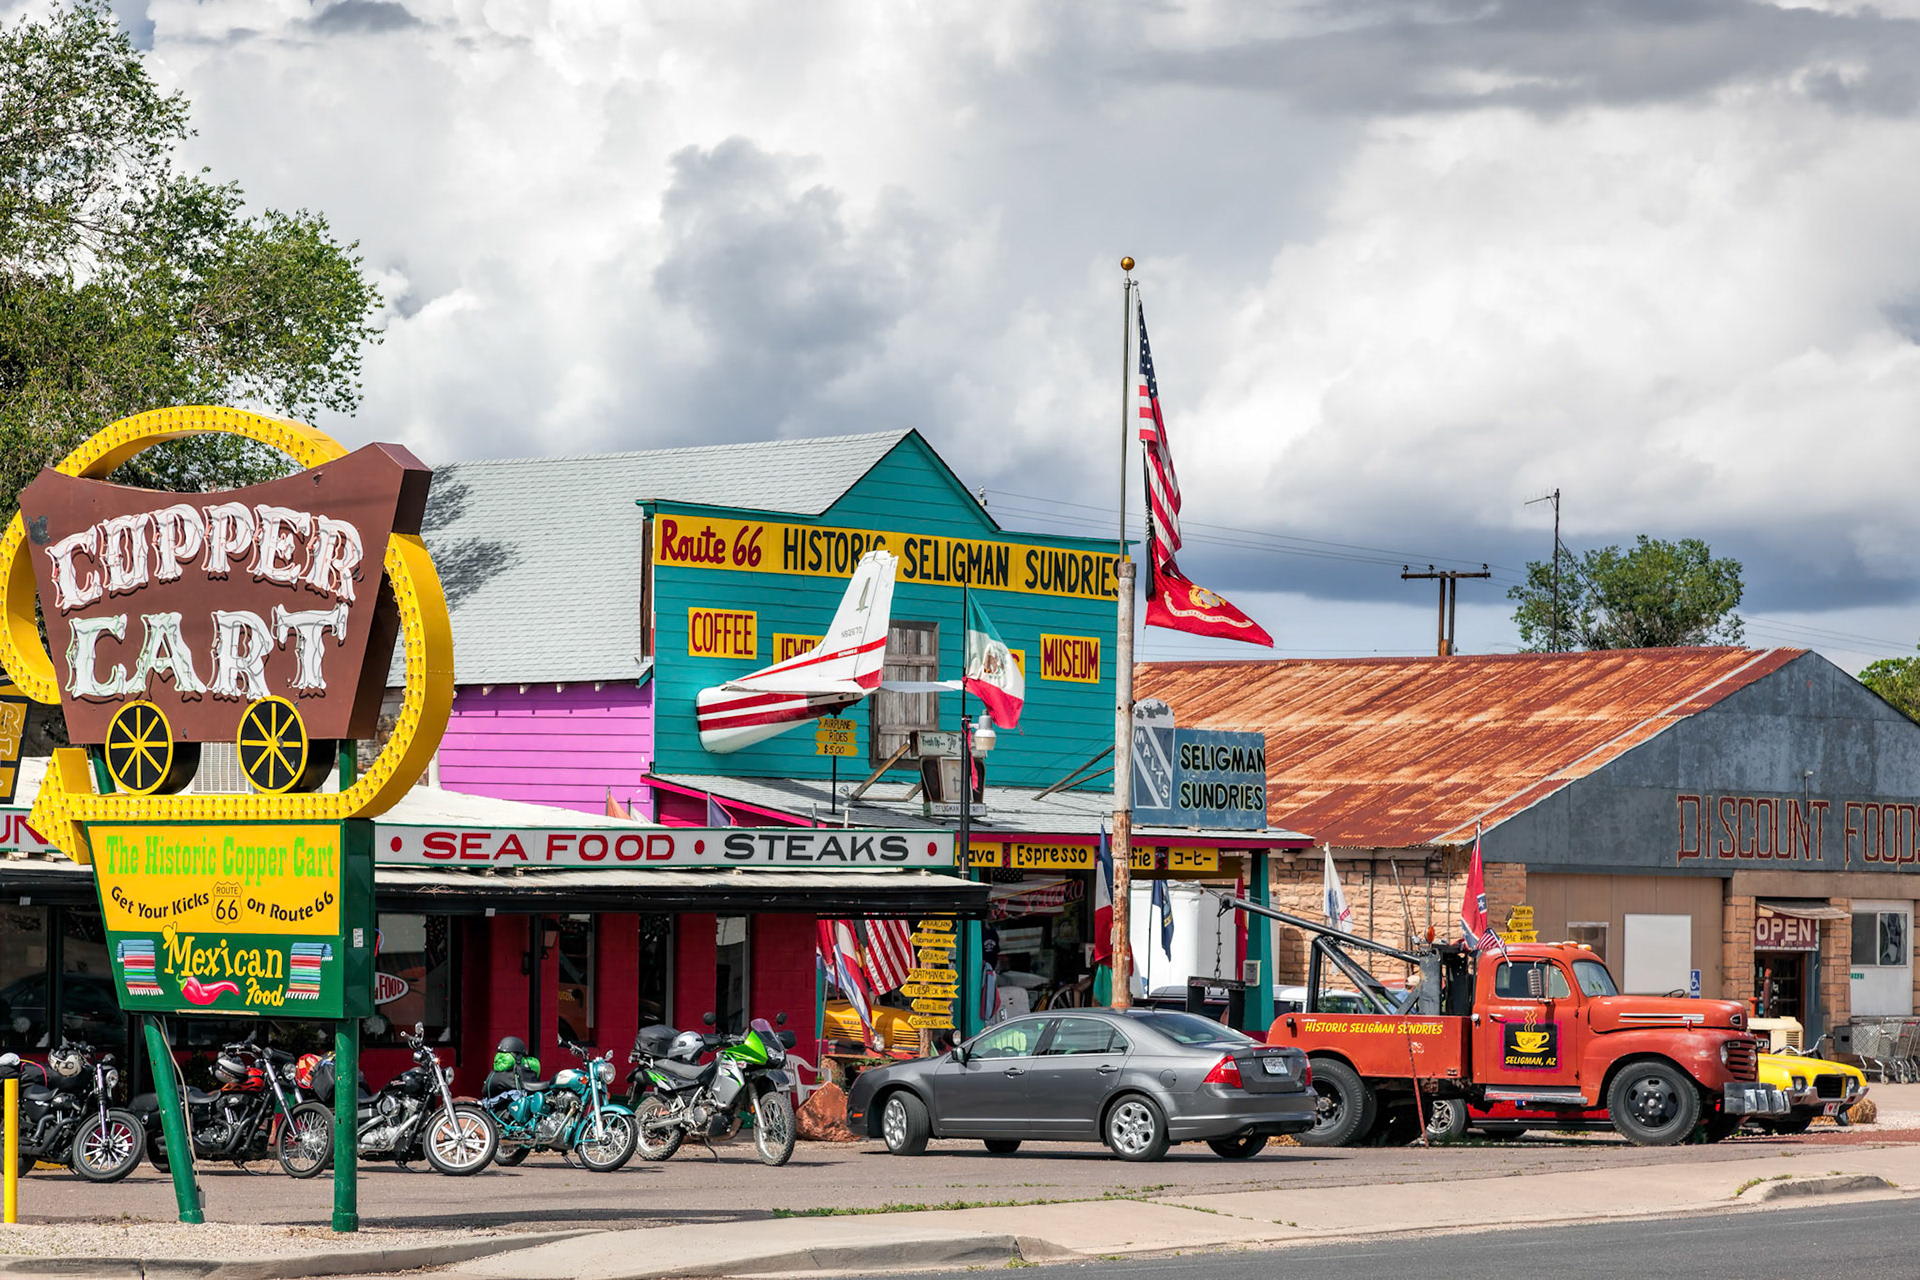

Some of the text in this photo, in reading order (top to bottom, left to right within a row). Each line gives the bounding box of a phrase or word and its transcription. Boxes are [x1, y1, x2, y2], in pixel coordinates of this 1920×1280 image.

[46, 502, 364, 609] COPPER
[661, 519, 726, 565] Route
[732, 525, 763, 568] 66
[903, 537, 1010, 588] SELIGMAN
[692, 612, 754, 655] COFFEE
[66, 603, 349, 699] CART
[1043, 638, 1099, 680] MUSEUM
[824, 719, 852, 731] AIRPLANE
[829, 732, 848, 743] RIDES
[1134, 730, 1169, 799] MALTS
[1180, 743, 1266, 774] SELIGMAN
[1179, 781, 1264, 812] SUNDRIES
[422, 832, 675, 861] SEA FOOD
[1677, 794, 1920, 870] DISCOUNT FOOD
[106, 835, 334, 887] The Historic Copper Cart
[724, 834, 909, 862] STEAKS
[1017, 845, 1087, 865] Espresso
[1174, 851, 1212, 865] コーヒー
[111, 886, 210, 919] Get Your Kicks
[216, 886, 238, 895] ROUTE
[216, 899, 238, 920] 66
[247, 890, 334, 922] on Route 66
[1756, 918, 1811, 942] OPEN
[162, 922, 283, 978] Mexican
[245, 977, 284, 1006] Food
[379, 975, 404, 999] FOOD
[1305, 1022, 1444, 1035] HISTORIC SELIGMAN SUNDRIES
[1505, 1056, 1557, 1066] SELIGMAN, AZ
